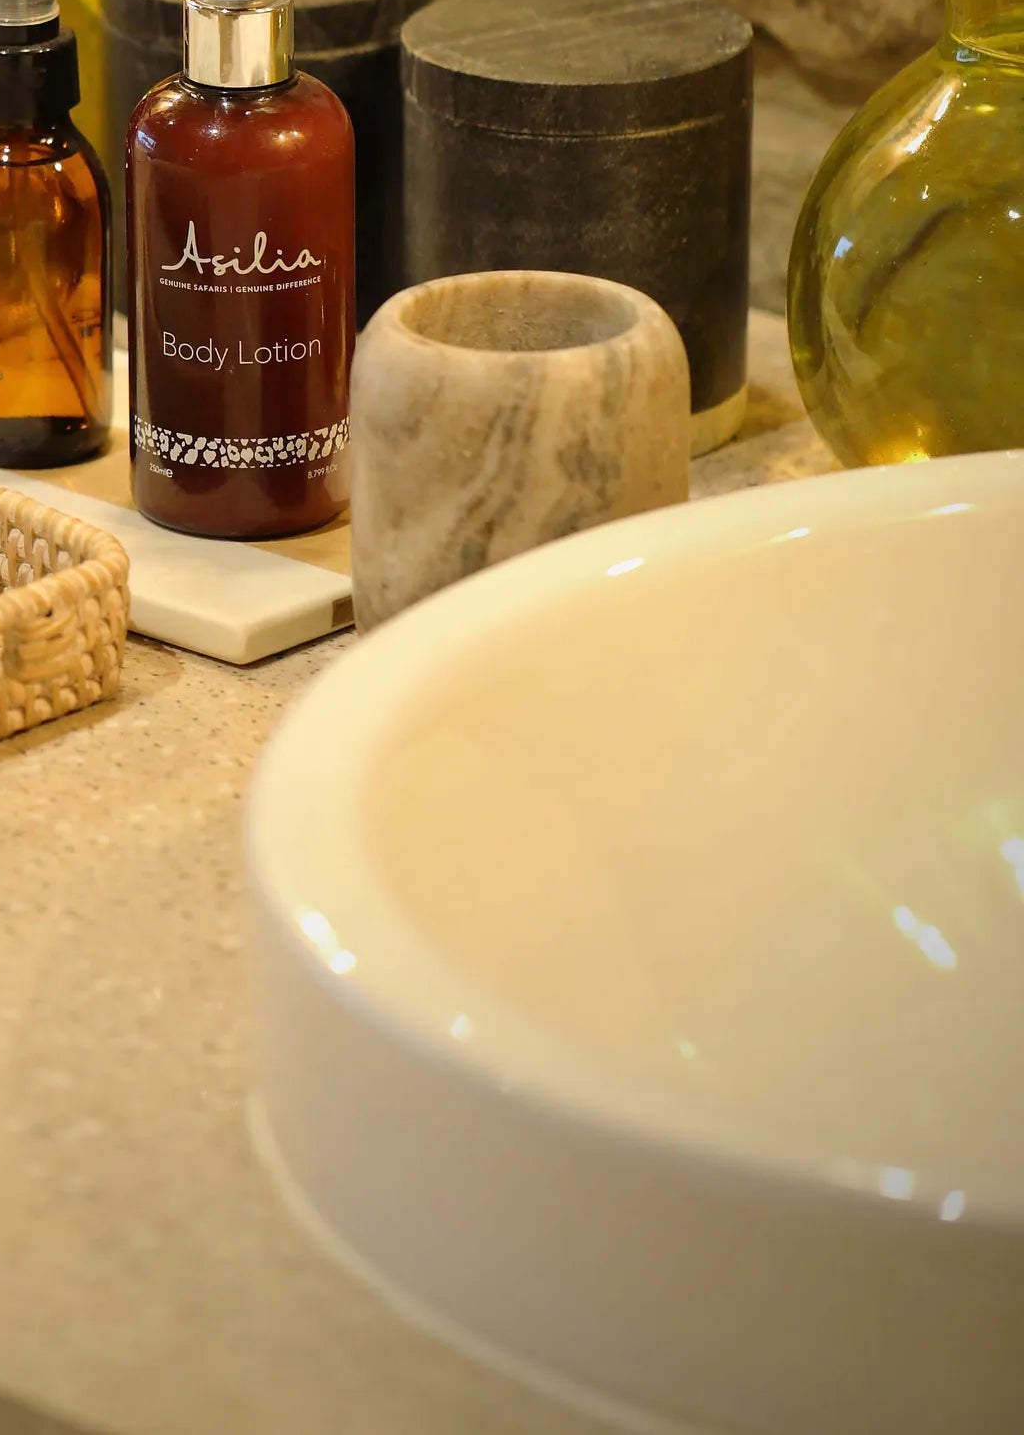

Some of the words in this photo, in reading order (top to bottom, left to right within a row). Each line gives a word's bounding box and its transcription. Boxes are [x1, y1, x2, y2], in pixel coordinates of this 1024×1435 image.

[161, 220, 322, 276] Asilia
[159, 277, 192, 290] GENUINE
[193, 283, 227, 293] SAFARIS
[235, 284, 274, 293] GENUINE
[276, 275, 322, 291] DIFFERENCE
[163, 331, 229, 371] Body
[238, 338, 321, 365] Lotion
